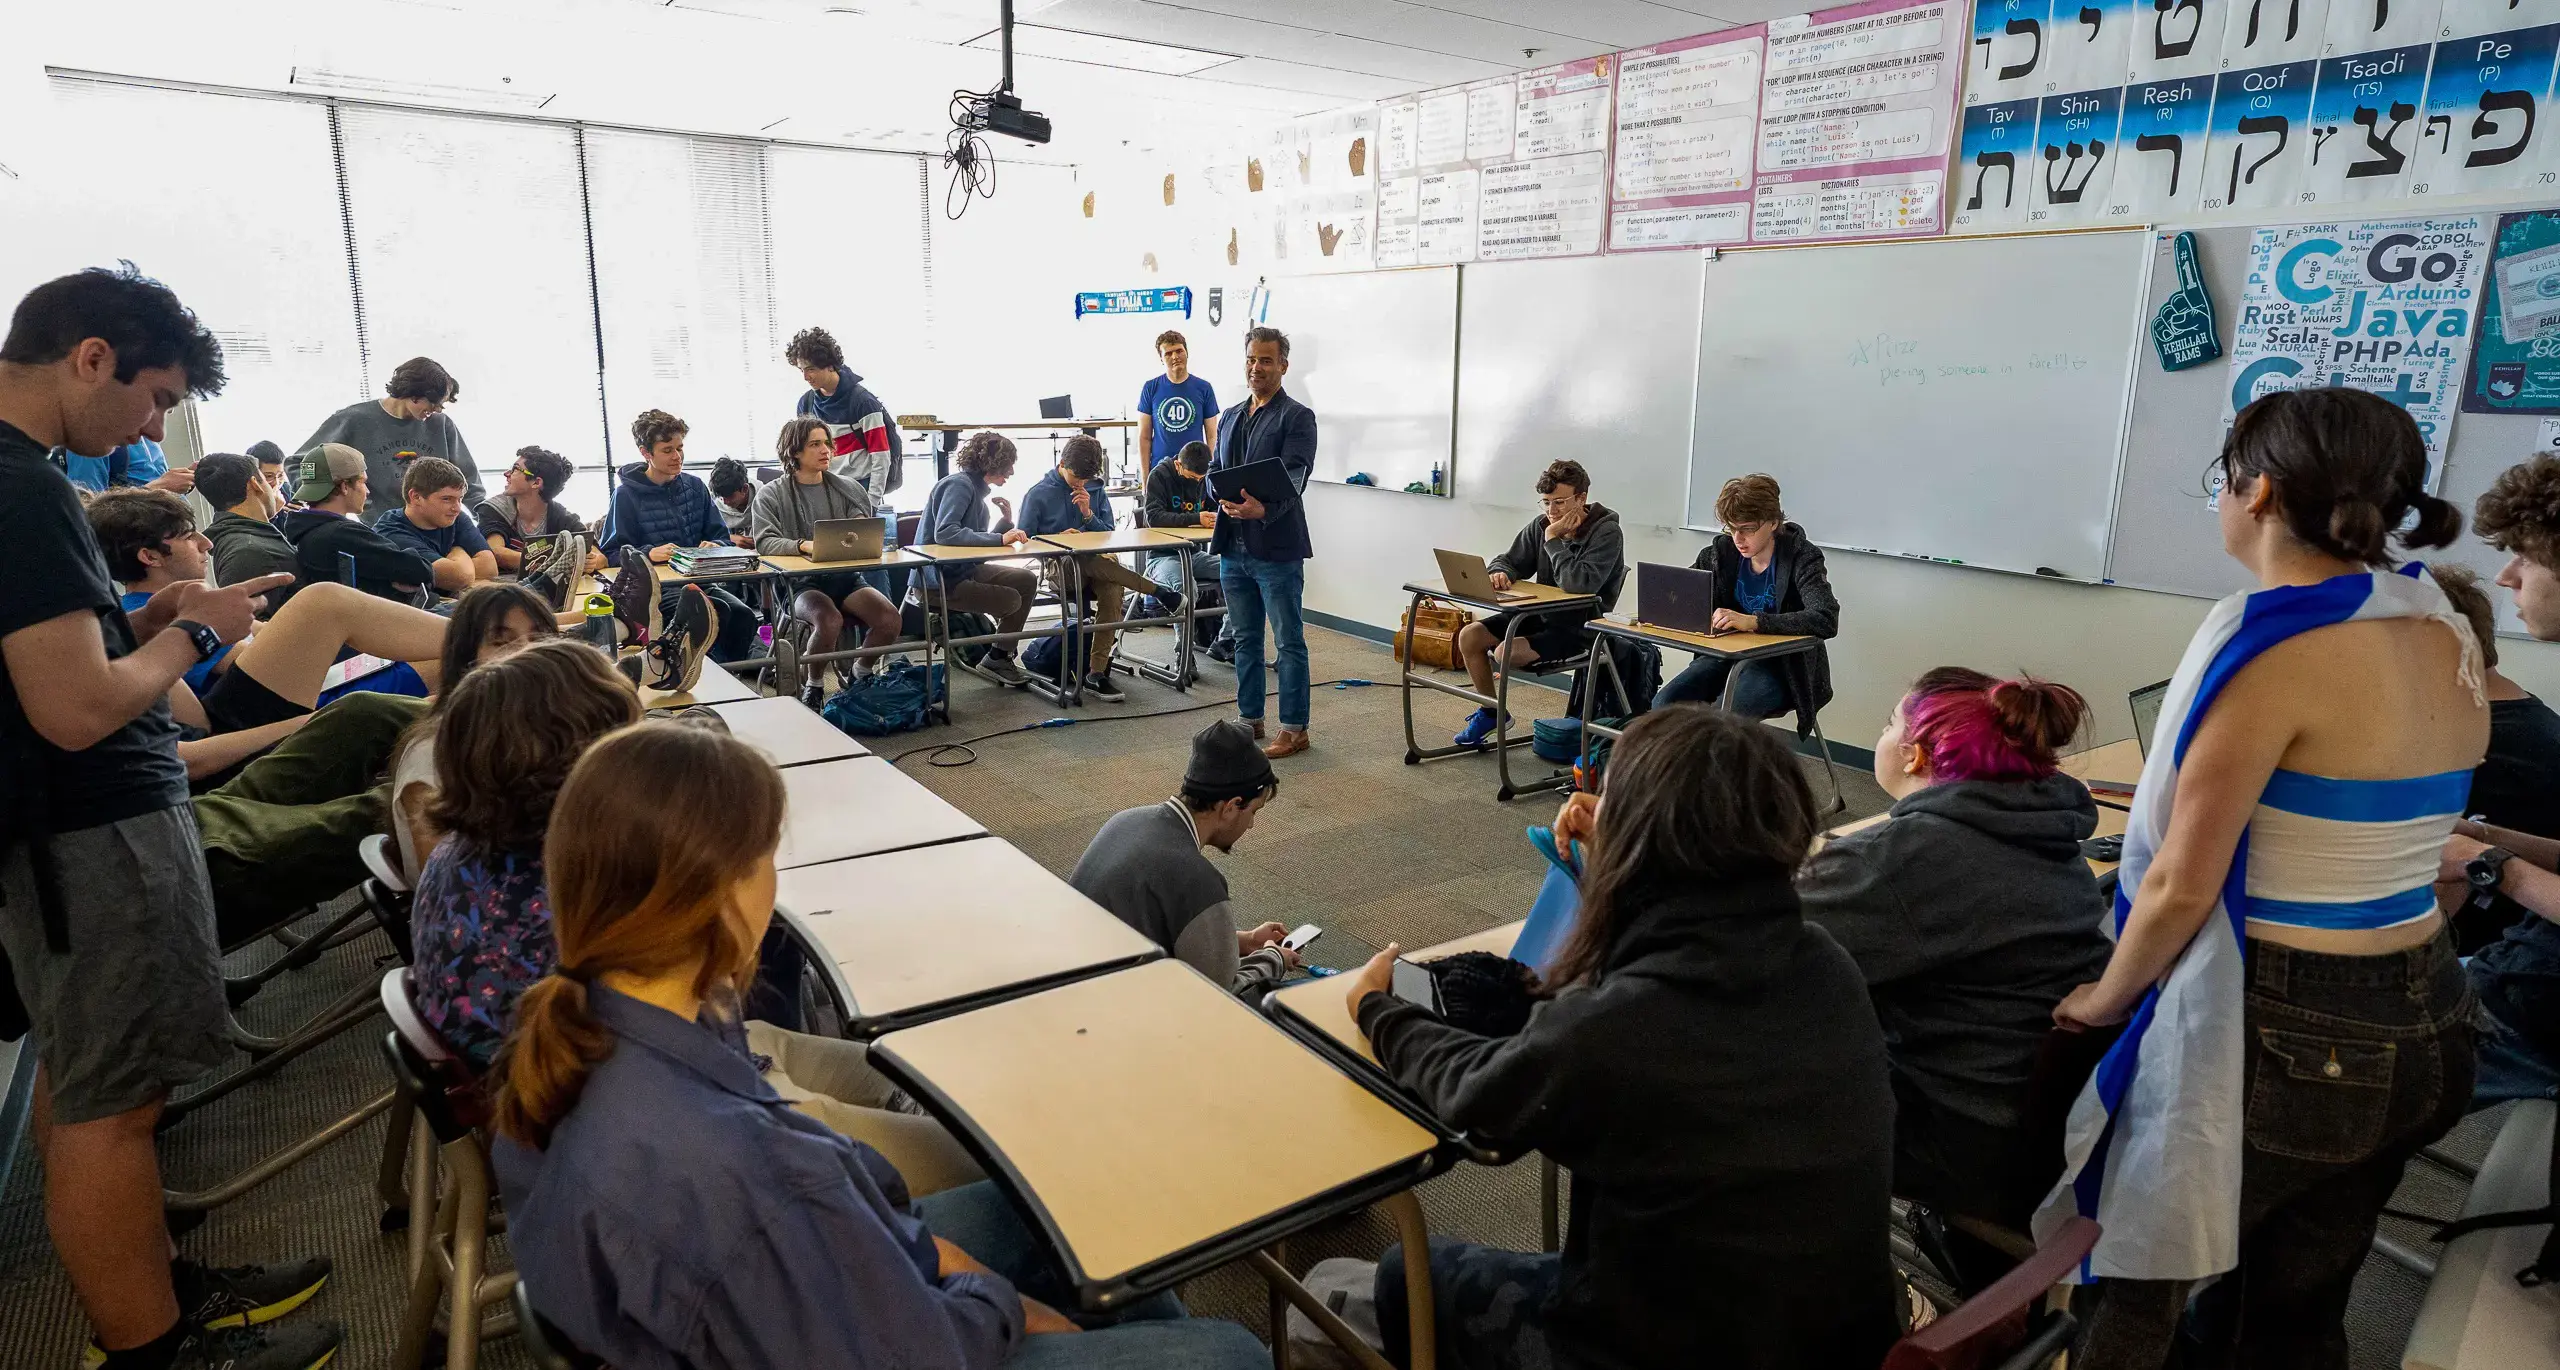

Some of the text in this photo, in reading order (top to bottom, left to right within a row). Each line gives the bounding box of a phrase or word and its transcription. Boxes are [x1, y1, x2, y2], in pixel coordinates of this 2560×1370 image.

[1785, 8, 1944, 42] LOOP WITH NUMBERS (START AT STOP BEFORE 100)
[1977, 26, 1995, 34] final
[2079, 5, 2101, 42] י
[2442, 26, 2450, 36] 6
[1998, 17, 2041, 81] כ
[2325, 43, 2333, 54] 7
[2477, 40, 2512, 62] Pe
[1781, 74, 1796, 84] LOOP
[1798, 71, 1811, 82] WITH
[1817, 66, 1846, 78] SEQUENCE
[1847, 63, 1865, 75] (EACH
[1866, 58, 1903, 72] CHARACTER
[1904, 56, 1911, 65] IN
[1912, 56, 1917, 64] A
[1918, 51, 1945, 63] STRING)
[2222, 59, 2229, 68] 8
[2341, 53, 2405, 80] Tsadi
[2130, 72, 2136, 81] 9
[2243, 68, 2289, 92] Qof
[2479, 65, 2500, 83] (P)
[1785, 84, 1823, 96] character
[2045, 82, 2056, 92] 10
[2353, 82, 2383, 98] (TS)
[1968, 93, 1978, 102] 20
[2143, 83, 2192, 105] Resh
[2060, 97, 2100, 116] Shin
[2250, 95, 2272, 110] (Q)
[2430, 97, 2458, 110] final
[1783, 112, 1798, 123] LOOP
[1800, 110, 1815, 121] (WITH
[1822, 106, 1850, 118] STOPPING
[1851, 102, 1886, 115] CONDITION)
[1986, 107, 2015, 124] Tav
[2156, 107, 2173, 121] (R)
[2315, 111, 2340, 123] final
[1650, 116, 1682, 127] POSSIBILITIES
[2065, 117, 2090, 132] (SH)
[1766, 130, 1783, 139] name
[1991, 128, 2005, 140] (T)
[2464, 89, 2535, 168] פ
[1790, 136, 1807, 145] name
[1831, 138, 1888, 152] person not
[2346, 100, 2416, 178] צ
[1781, 158, 1798, 166] name
[2136, 132, 2183, 197] ר
[2228, 114, 2288, 205] ק
[2044, 137, 2106, 204] ש
[1757, 174, 1793, 185] CONTAINERS
[1821, 179, 1859, 190] DICTIONARIES
[1967, 150, 2015, 210] ת
[2538, 172, 2555, 184] 70
[2412, 183, 2429, 194] 80
[1822, 194, 1847, 202] months
[2301, 192, 2315, 202] 90
[2111, 205, 2129, 215] 200
[2203, 199, 2221, 209] 100
[1955, 215, 1970, 225] 400
[2031, 211, 2047, 221] 300
[2302, 225, 2338, 234] SPARK
[2361, 222, 2422, 231] Mathematica
[2424, 218, 2478, 231] Scratch
[2286, 229, 2300, 238] F#
[2348, 230, 2374, 244] Lisp
[2420, 233, 2473, 244] COBOL
[2251, 245, 2260, 255] D
[2351, 245, 2370, 253] Dylan
[2249, 229, 2274, 284] Pascal
[2333, 255, 2359, 266] Algol
[2367, 234, 2456, 283] Go
[2276, 238, 2344, 304] C
[2304, 261, 2321, 284] Logo
[2326, 270, 2359, 280] Elixir
[2453, 249, 2473, 288] Malbolge
[2243, 293, 2272, 303] Squeak
[2377, 283, 2471, 300] Arduino
[2331, 287, 2346, 313] Shell
[2244, 305, 2297, 325] Rust
[2300, 305, 2326, 316] Perl
[2331, 290, 2468, 338] Java
[2302, 315, 2342, 323] MUMPS
[2238, 325, 2267, 337] Ruby
[2266, 327, 2319, 344] Scala
[2162, 332, 2208, 355] KEHILLAH
[2238, 338, 2257, 348] Lua
[2261, 344, 2316, 353] NATURAL
[2403, 340, 2450, 357] Ada
[2174, 347, 2202, 364] RAMS
[2233, 349, 2254, 357] Apex
[2333, 341, 2402, 362] PHP
[2310, 338, 2331, 388] TypeScript
[2350, 364, 2397, 373] Scheme
[2402, 358, 2435, 369] Turing
[2344, 374, 2394, 383] Smalltalk
[2416, 371, 2428, 389] SAS
[2429, 358, 2457, 412] Processing
[2256, 381, 2302, 392] Haskell
[1168, 405, 1185, 420] 40
[377, 440, 434, 455] VANCOUVER
